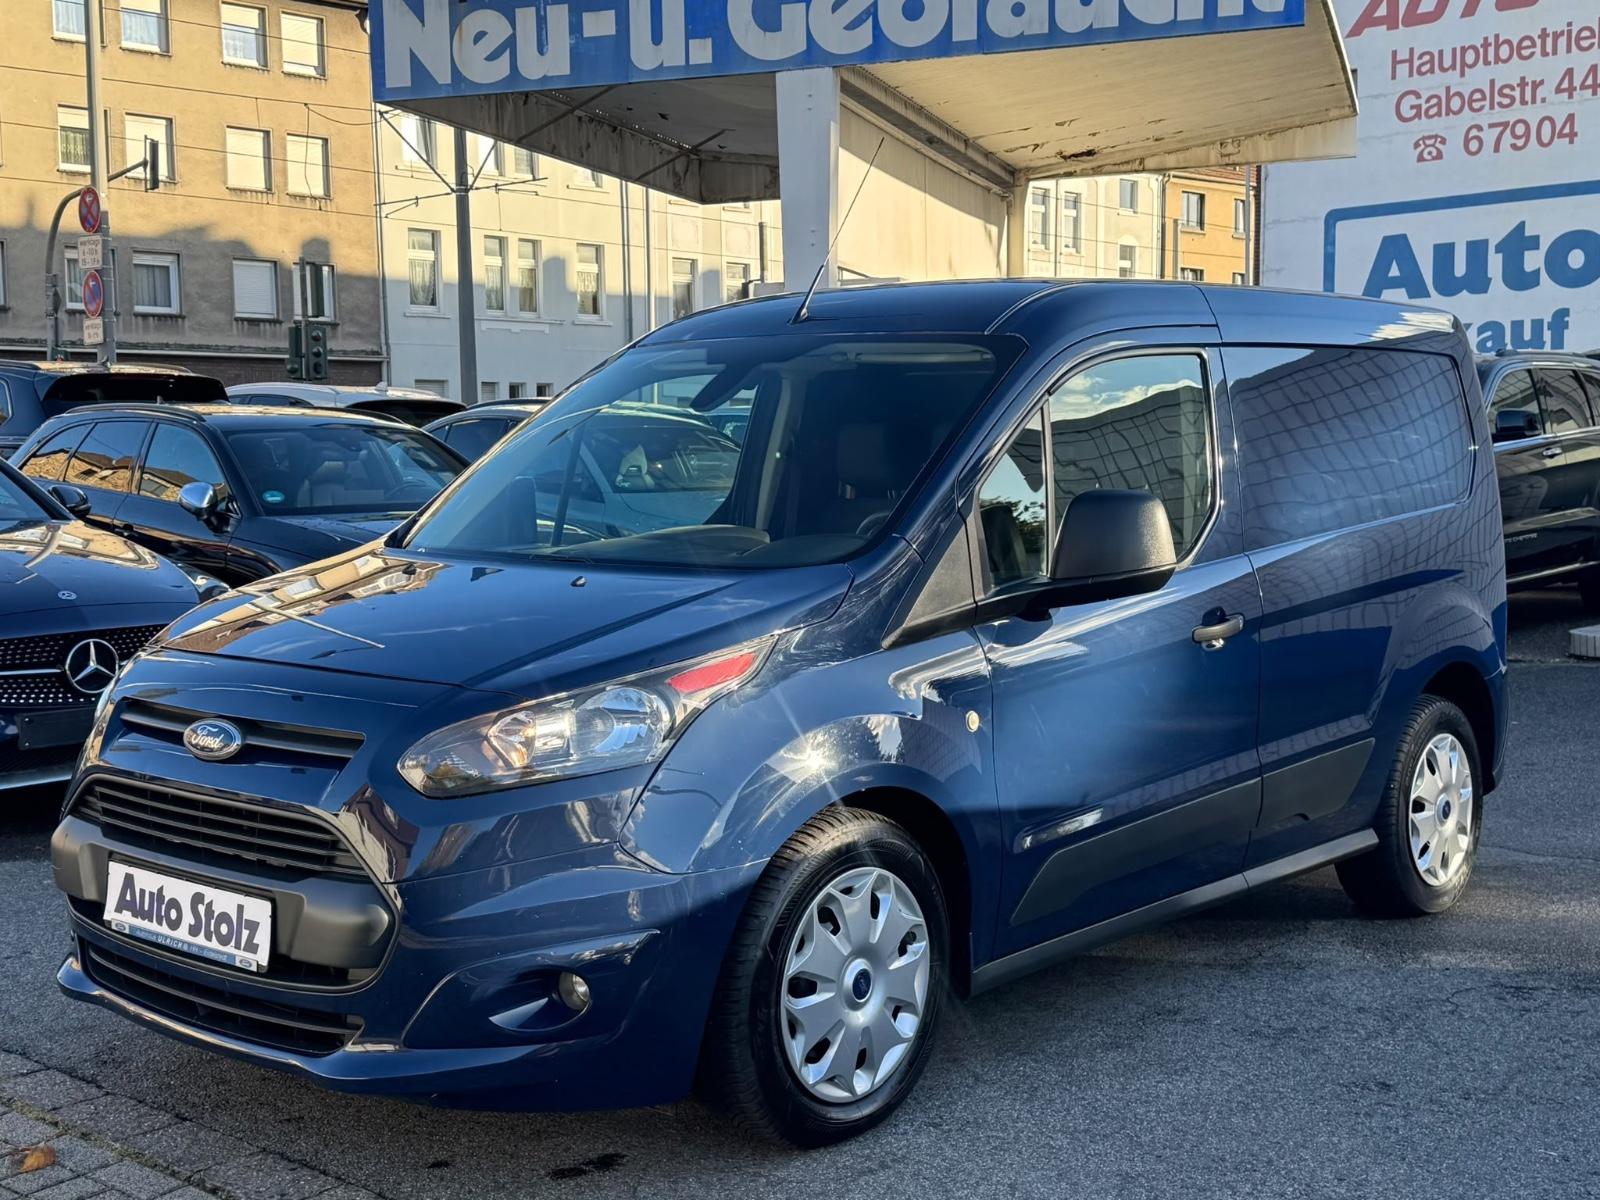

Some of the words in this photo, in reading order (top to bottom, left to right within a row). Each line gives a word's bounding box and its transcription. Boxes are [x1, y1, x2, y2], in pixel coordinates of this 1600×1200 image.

[1390, 17, 1600, 80] Hauptbetrie
[1395, 76, 1546, 123] Gabelstr.
[1555, 64, 1600, 99] 44
[1463, 113, 1578, 156] 67904
[1362, 220, 1600, 300] Auto
[1464, 308, 1570, 353] auf
[191, 724, 225, 749] Ford
[114, 872, 183, 931] Auto
[188, 891, 260, 955] Stolz
